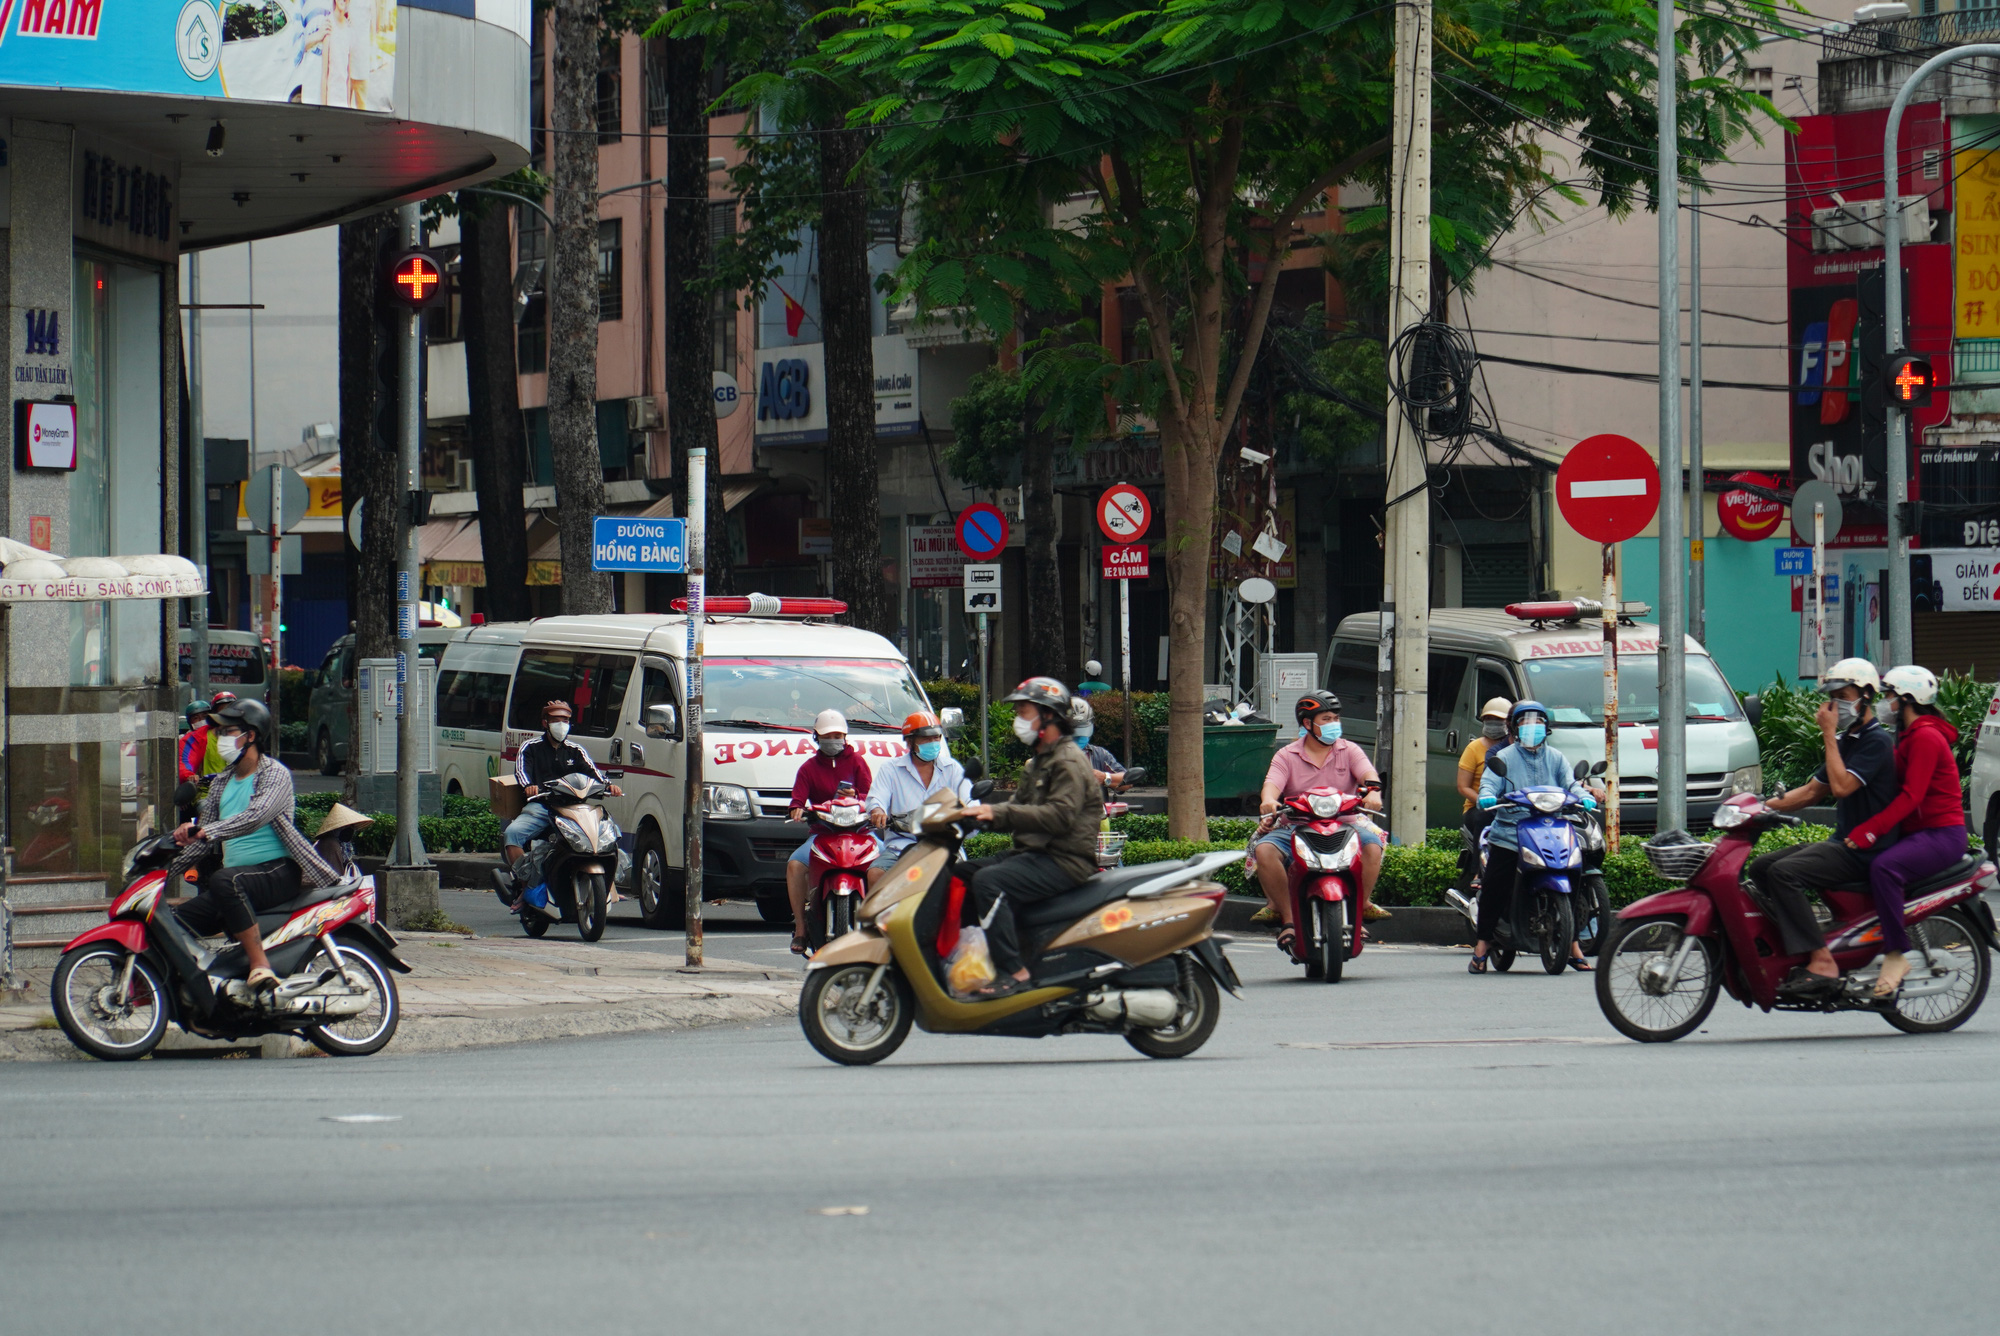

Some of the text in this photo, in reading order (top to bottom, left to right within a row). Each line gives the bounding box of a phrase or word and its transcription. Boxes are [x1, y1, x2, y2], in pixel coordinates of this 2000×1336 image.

[20, 0, 100, 36] NAM
[1964, 191, 2000, 221] LẨ
[25, 309, 59, 356] 144
[1801, 339, 1861, 386] FP
[15, 362, 67, 384] CHÂU VĂN LIÊM
[713, 386, 737, 402] CB
[757, 359, 810, 421] ACB
[42, 428, 69, 440] MoneyGram
[1921, 453, 1933, 464] CTY
[1934, 448, 1943, 463] CỔ
[1943, 449, 1963, 463] PHẦN
[617, 523, 664, 538] ĐƯỜNG
[596, 539, 680, 563] HỒNG BÀNG
[1110, 548, 1142, 564] CẤM
[1783, 551, 1804, 559] ĐƯỜNG
[1104, 565, 1148, 577] XE 2 VÀ 3 BÁNH
[1781, 560, 1793, 570] LÃO
[1956, 559, 1989, 579] GIẢM
[17, 584, 37, 597] TY
[45, 579, 87, 597] CHIẾU
[98, 580, 133, 596] SÁNG
[1963, 580, 1989, 601] ĐẾN
[1530, 640, 1688, 658] AMBUAN
